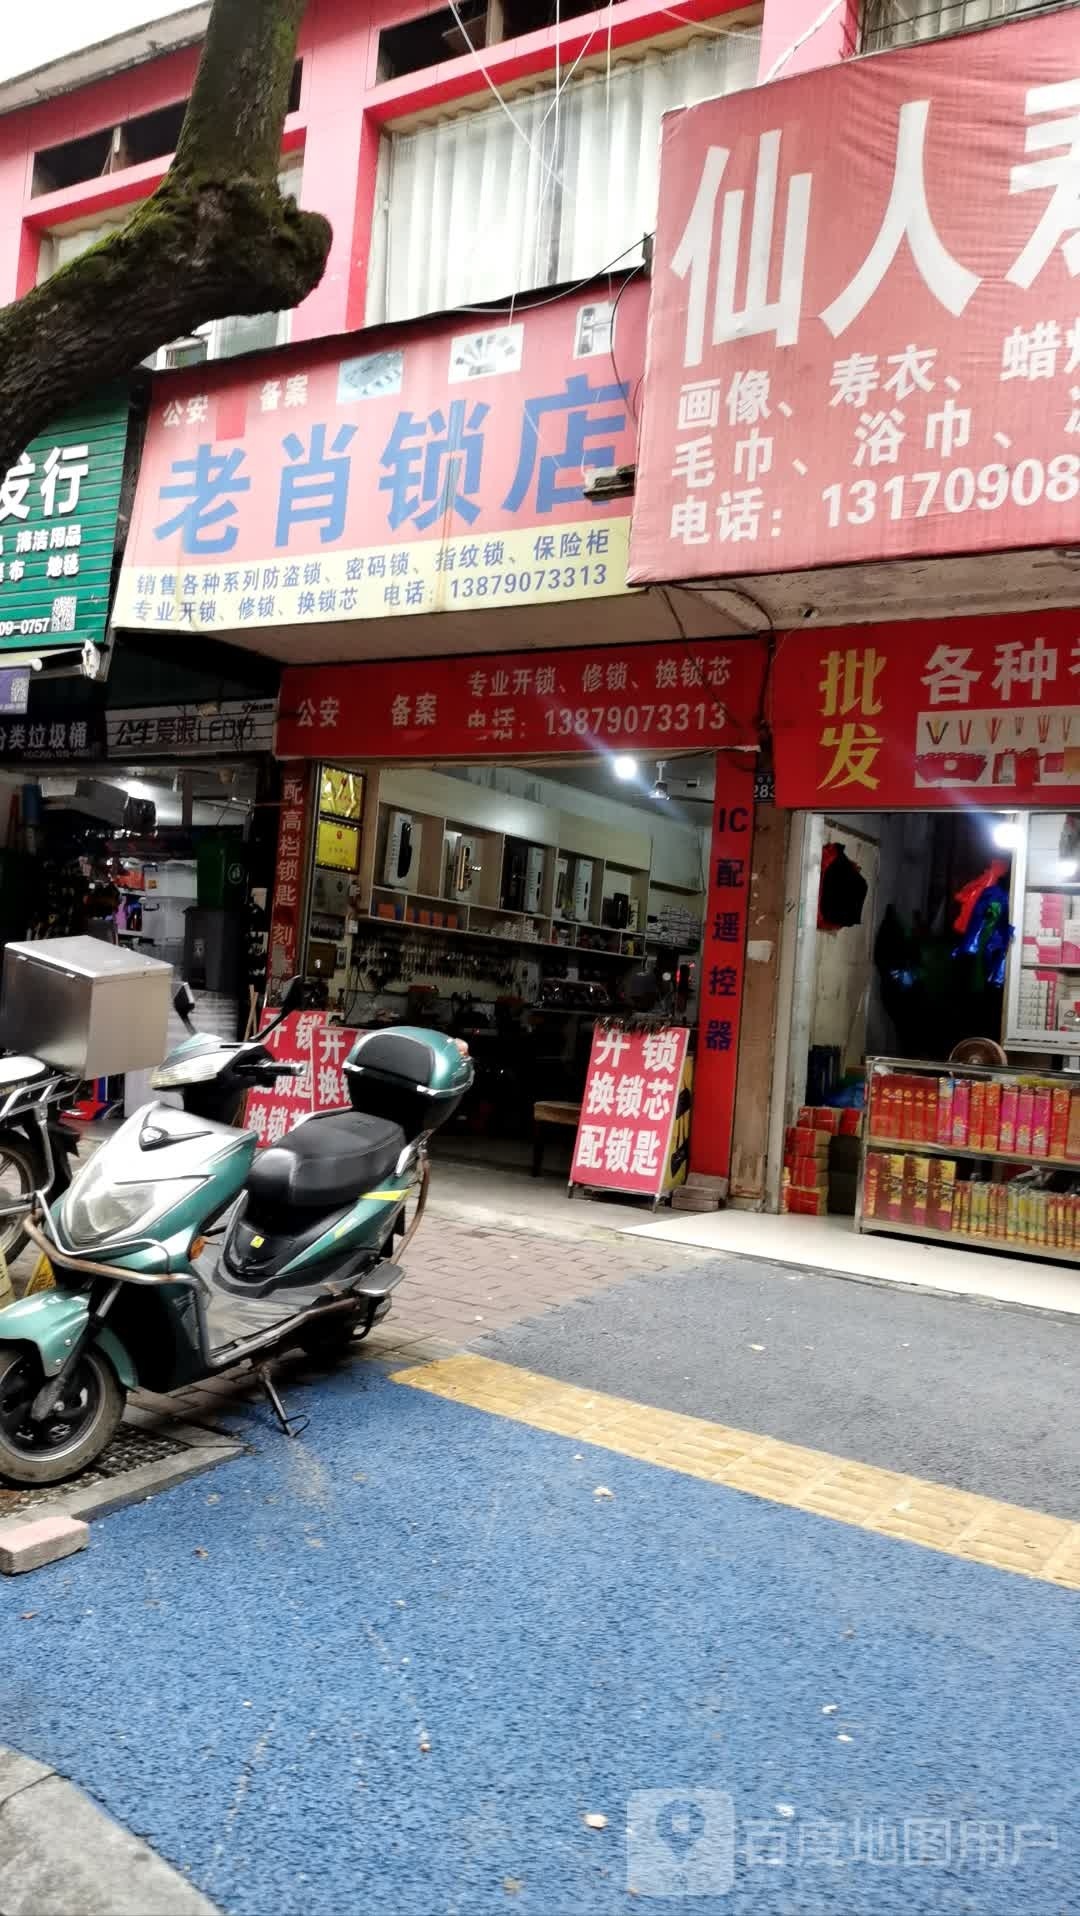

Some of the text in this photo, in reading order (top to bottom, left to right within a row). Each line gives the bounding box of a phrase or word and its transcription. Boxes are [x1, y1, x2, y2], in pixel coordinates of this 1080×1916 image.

[999, 320, 1080, 382] 蜡
[162, 375, 309, 427] 公安 备案
[153, 374, 630, 555] 老肖锁店
[822, 454, 1080, 528] 13170908
[16, 524, 81, 553] 清洁用品
[0, 560, 25, 583] 布
[450, 564, 608, 599] 13879073313
[297, 698, 340, 727] 公安
[391, 694, 437, 727] 备案
[545, 703, 727, 737] 13879073313
[817, 647, 887, 791] 批发
[586, 1071, 674, 1121] 换锁芯
[576, 1125, 661, 1177] 配锁匙
